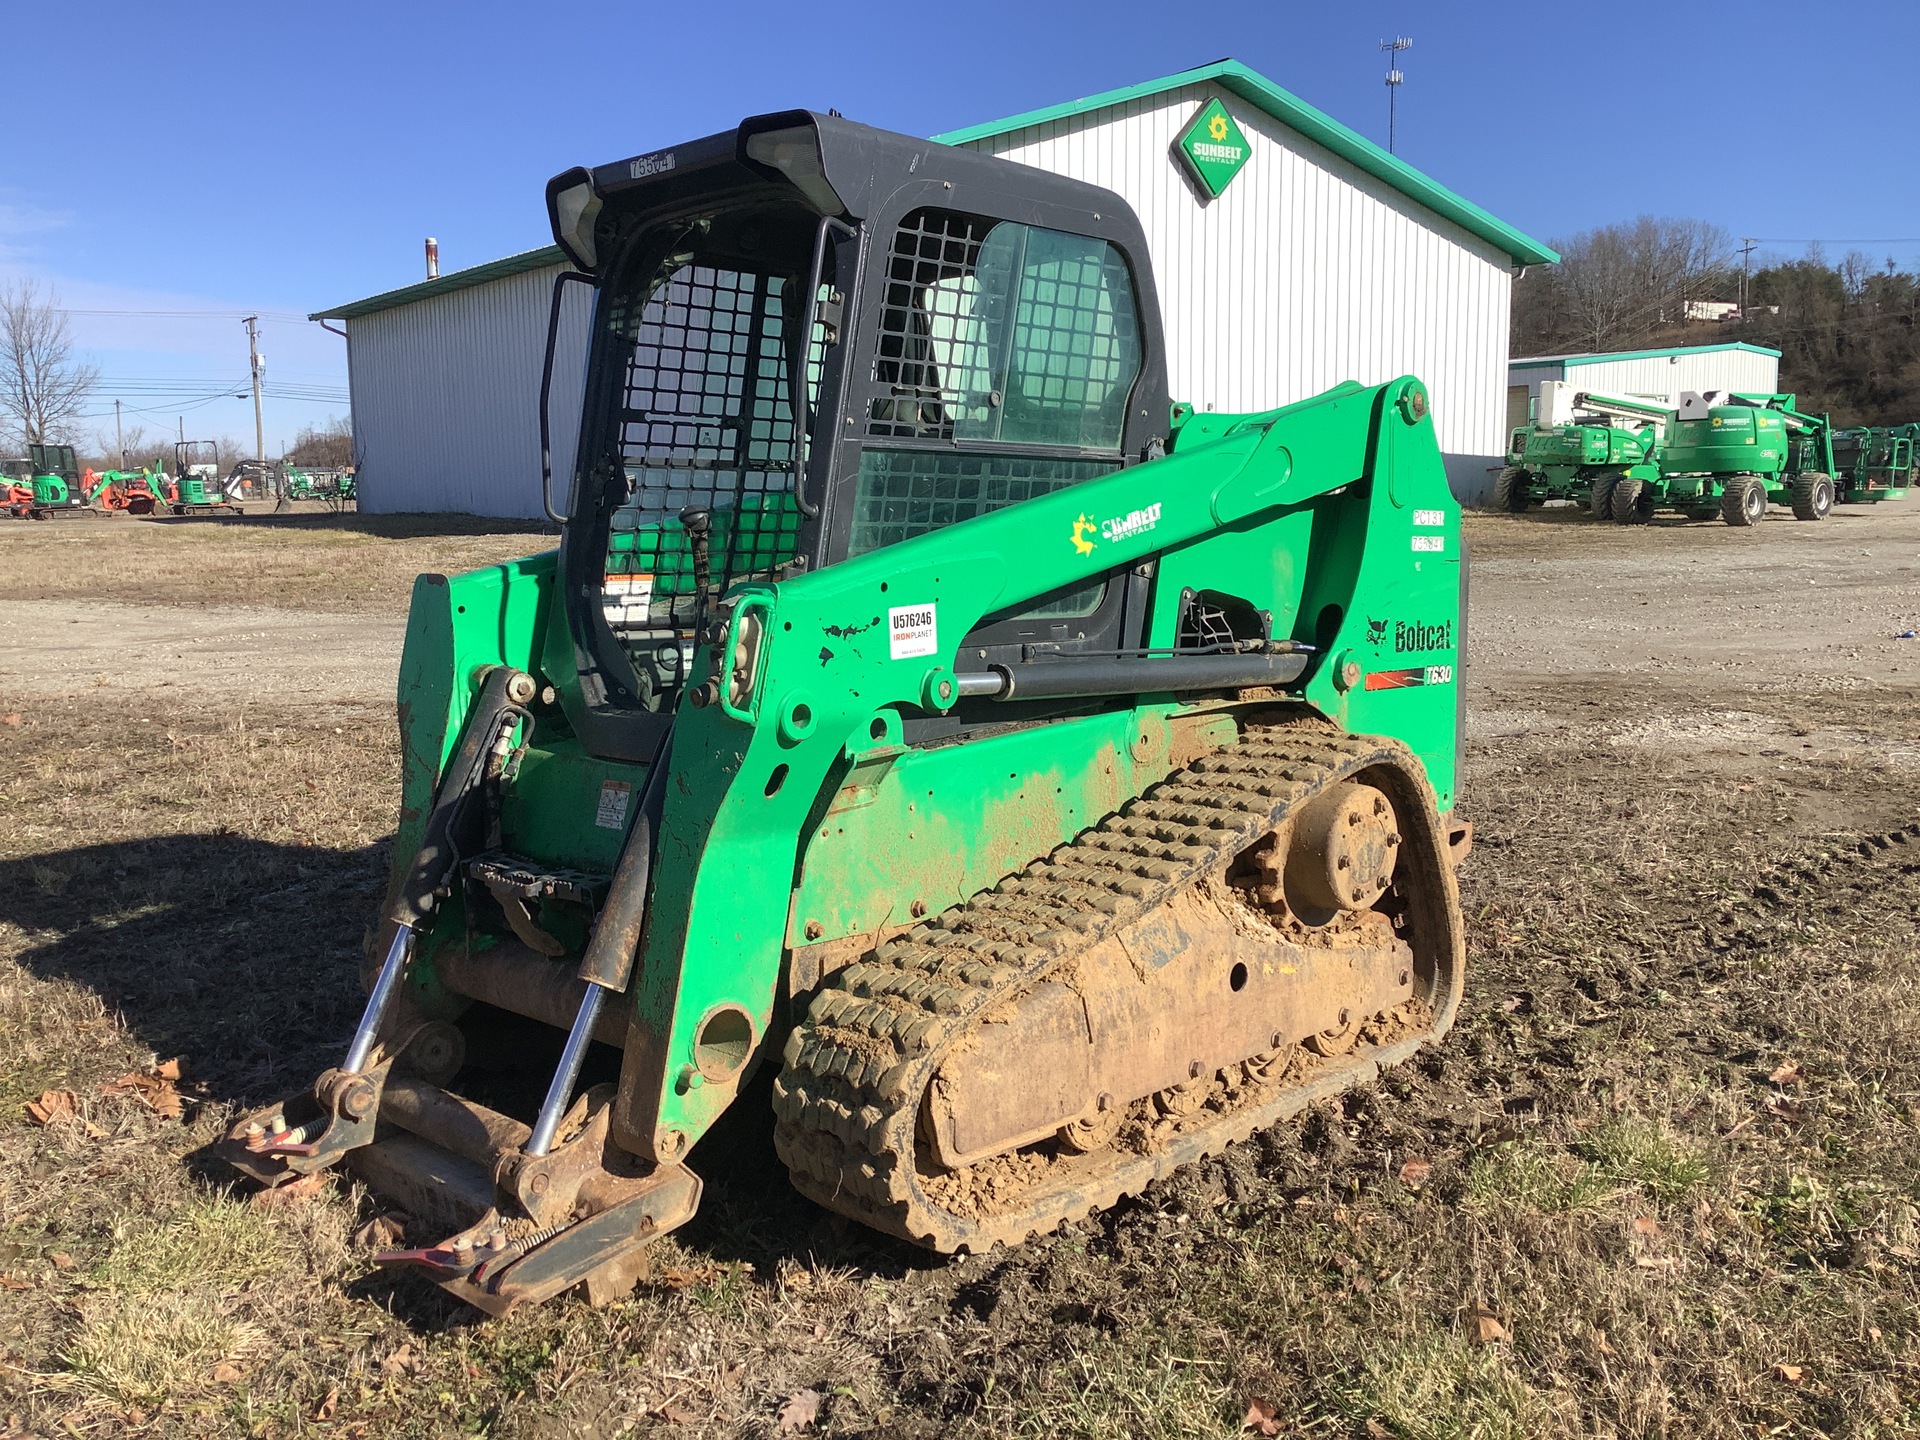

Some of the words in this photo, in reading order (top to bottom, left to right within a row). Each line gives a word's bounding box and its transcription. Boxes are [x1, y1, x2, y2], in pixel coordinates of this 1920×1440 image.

[1193, 142, 1242, 160] SUNBELT
[1199, 156, 1236, 165] RENTALS
[893, 611, 932, 629] U576246
[893, 629, 933, 642] IRONPLANET
[1395, 619, 1451, 653] Bobcat
[1426, 665, 1452, 686] T630
